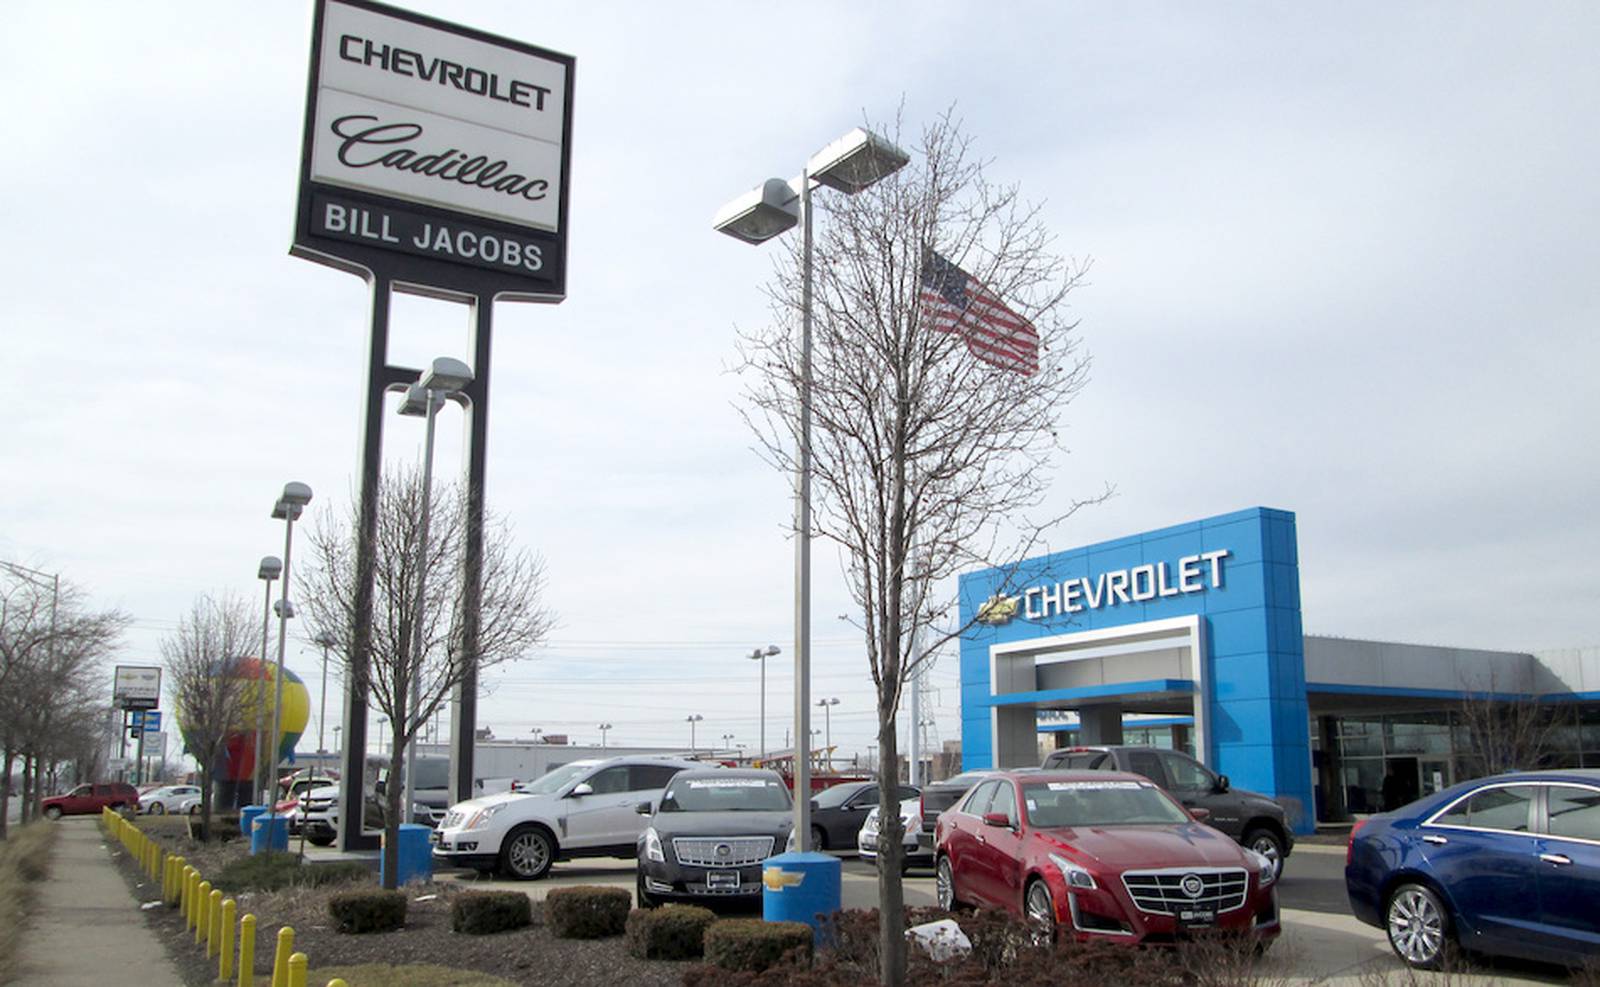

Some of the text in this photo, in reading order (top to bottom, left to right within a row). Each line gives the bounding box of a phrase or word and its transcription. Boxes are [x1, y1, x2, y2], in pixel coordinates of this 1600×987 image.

[339, 34, 551, 111] CHEVROLET
[331, 115, 549, 201] Cadillac
[324, 203, 543, 271] BILL JACOBS
[1025, 549, 1229, 619] CHEVROLET
